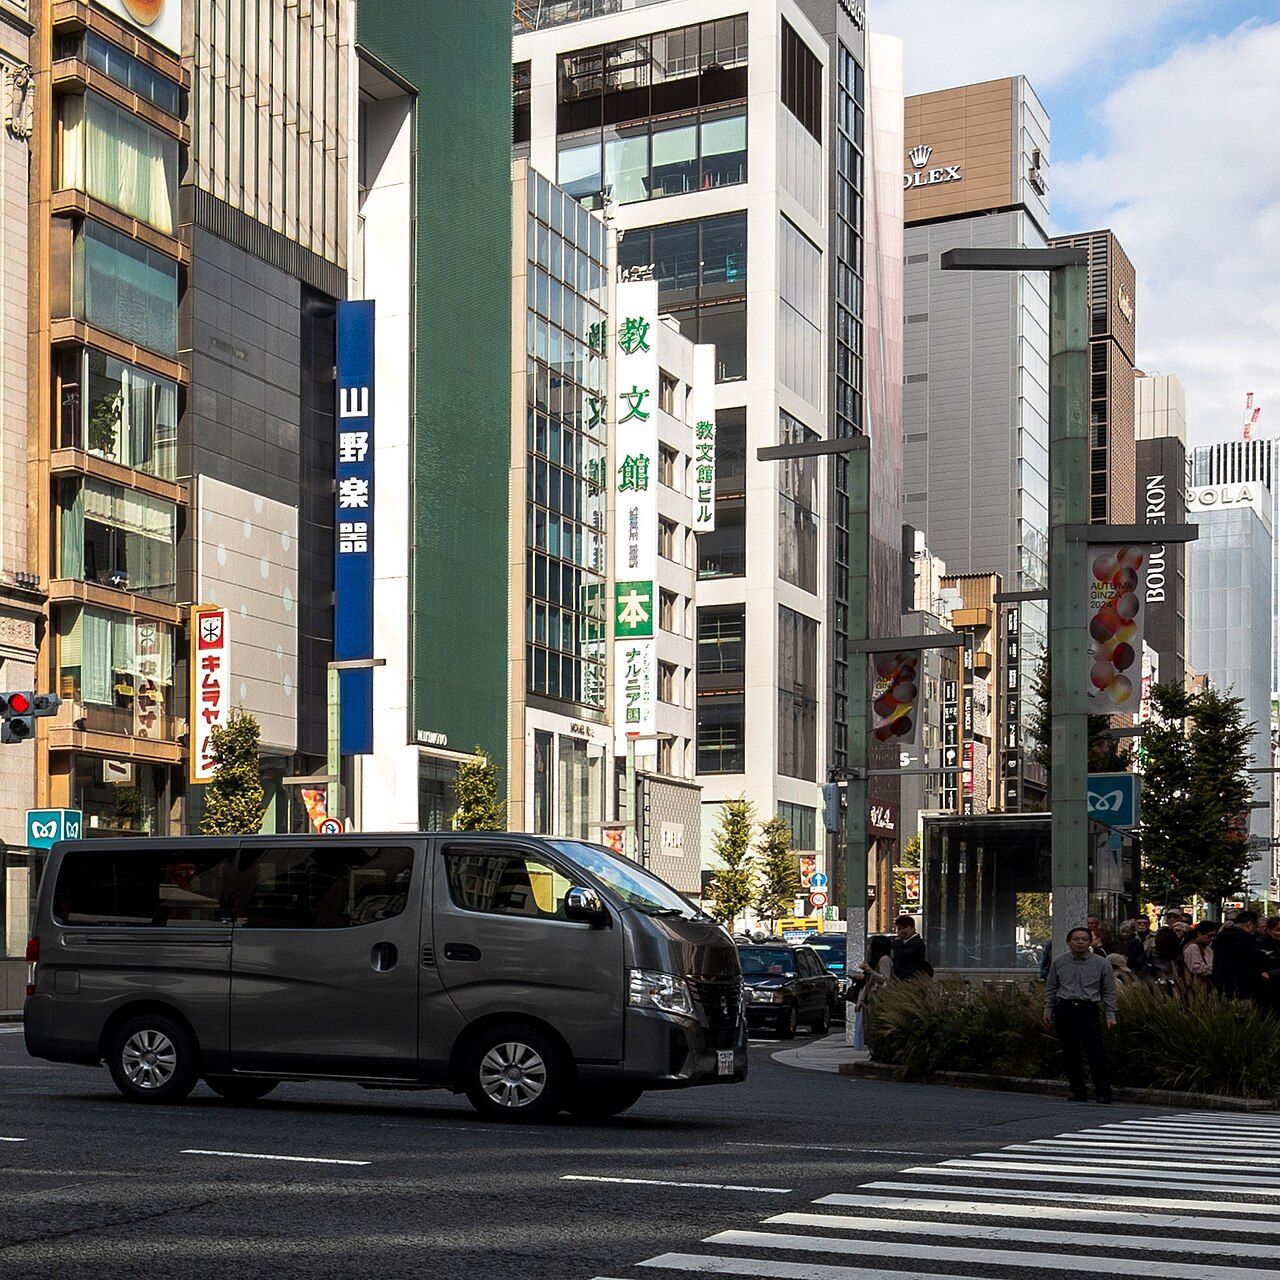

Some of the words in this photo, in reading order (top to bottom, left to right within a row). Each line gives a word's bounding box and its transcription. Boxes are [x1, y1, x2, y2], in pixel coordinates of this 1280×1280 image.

[618, 316, 651, 493] 教文館
[339, 386, 369, 553] 山野楽器
[695, 421, 714, 524] 教文館ビル
[1185, 485, 1254, 505] POLA
[628, 506, 639, 541] SINCE
[1090, 582, 1132, 590] AUTUMN
[1090, 591, 1122, 600] GINZA
[618, 589, 650, 629] 本
[1090, 601, 1113, 609] 2024
[625, 647, 641, 724] ナルニア国
